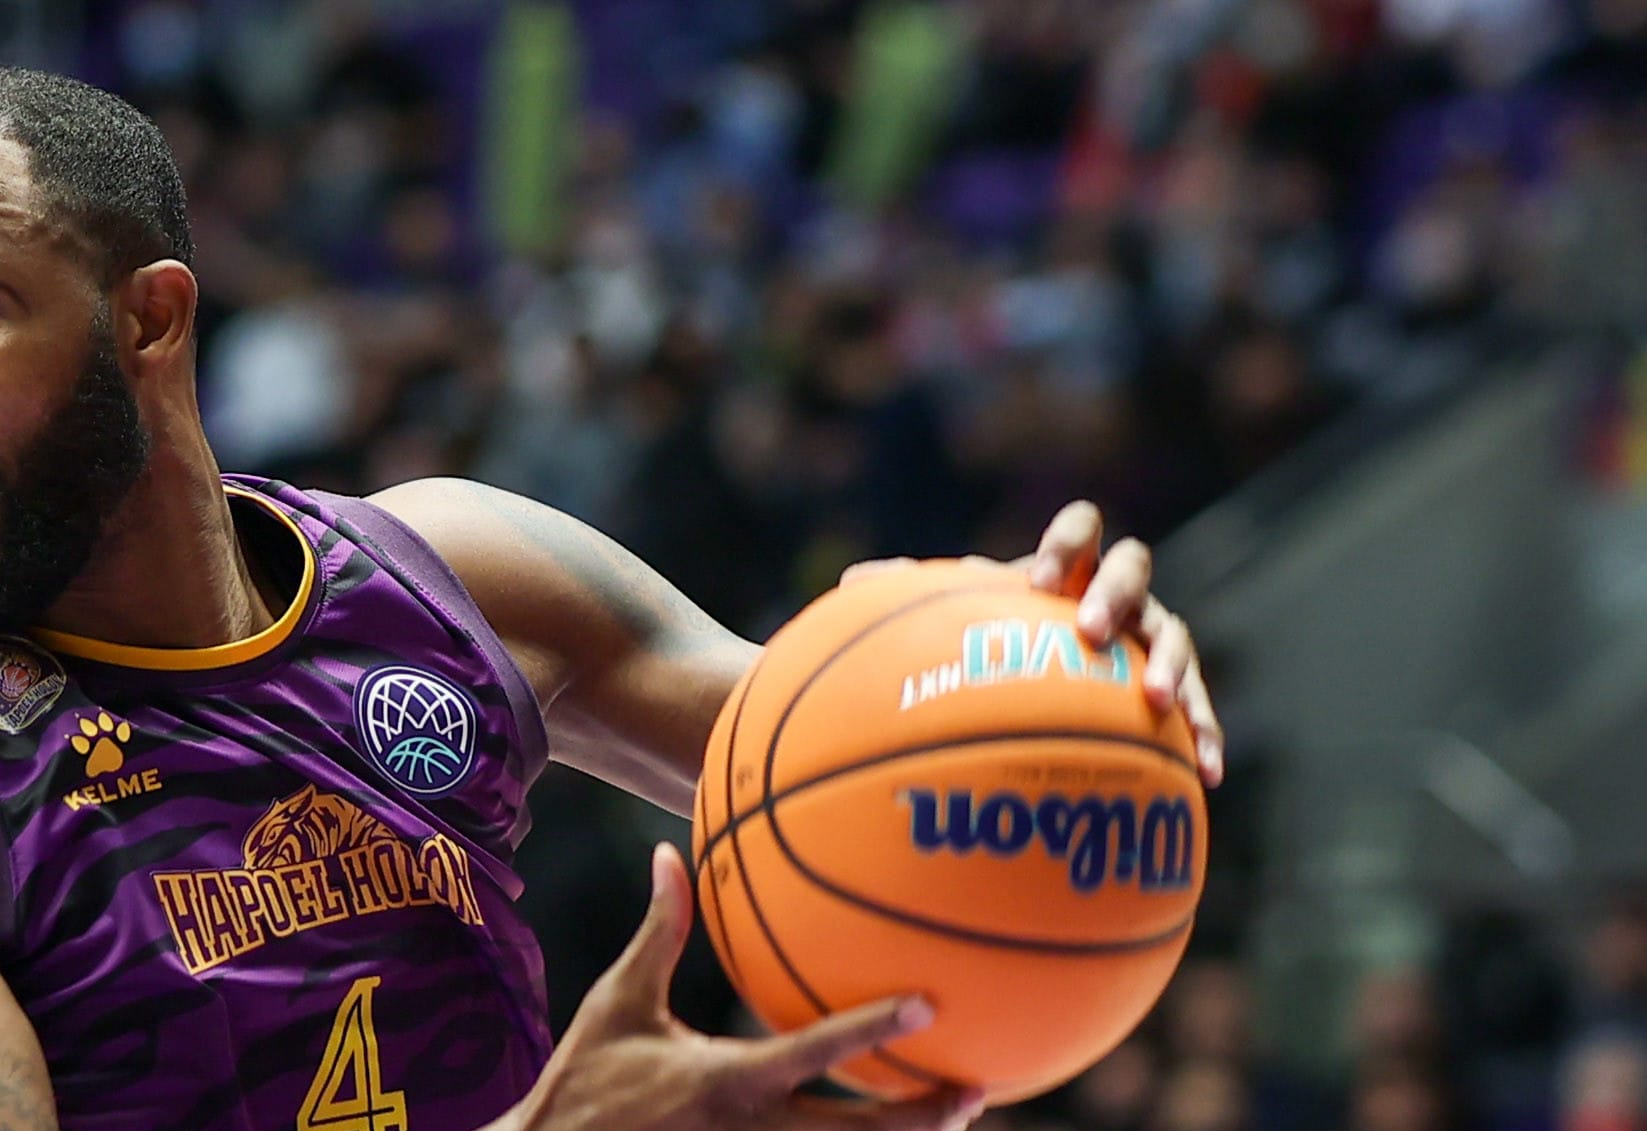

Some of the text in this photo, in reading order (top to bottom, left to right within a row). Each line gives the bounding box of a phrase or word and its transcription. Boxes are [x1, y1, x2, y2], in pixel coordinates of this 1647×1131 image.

[63, 768, 163, 812] KELME
[909, 789, 1192, 891] Wilson
[153, 832, 485, 976] HAPOEL HOLON
